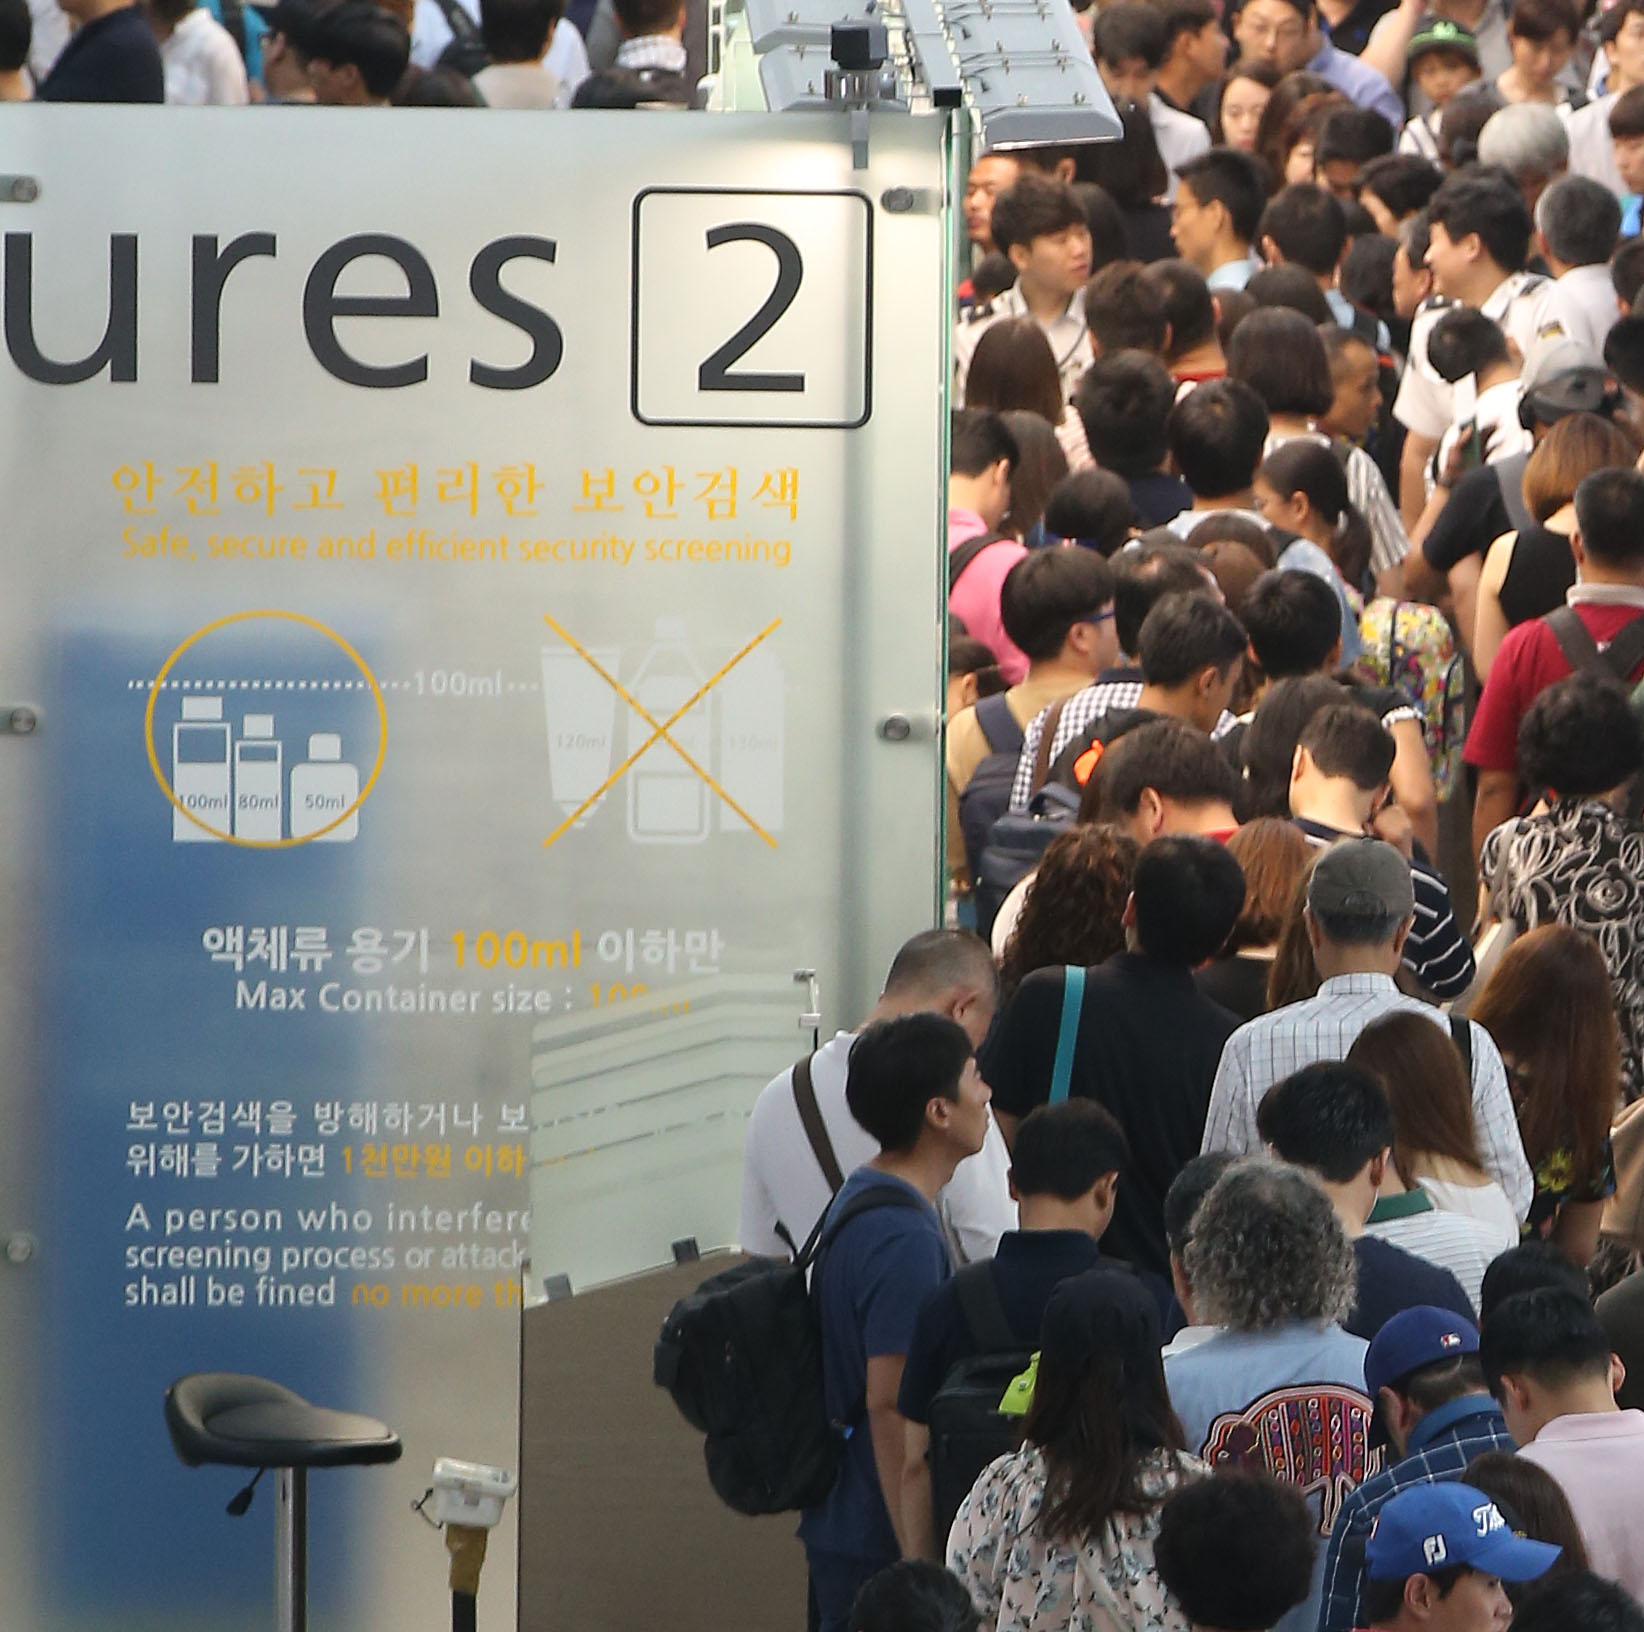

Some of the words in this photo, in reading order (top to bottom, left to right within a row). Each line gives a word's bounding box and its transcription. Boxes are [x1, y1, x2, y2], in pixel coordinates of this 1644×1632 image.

[2, 230, 564, 389] ures
[697, 223, 806, 392] 2
[111, 460, 344, 518] 안전하고
[375, 460, 546, 518] 편리한
[572, 465, 800, 523] 보안검색
[121, 526, 197, 562] Safe,
[208, 534, 308, 560] secure
[318, 528, 376, 560] and
[385, 528, 510, 562] efficient
[519, 530, 633, 566] security
[644, 530, 792, 567] screening
[413, 670, 502, 697] 100ml
[177, 793, 229, 810] 100ml
[238, 793, 279, 810] 80ml
[304, 793, 345, 810] 50ml
[202, 925, 332, 972] 액체류
[345, 926, 430, 974] 용기
[451, 929, 582, 969] 100ml
[596, 928, 725, 974] 이하만
[234, 979, 306, 1010] Max
[318, 979, 482, 1013] Container
[492, 982, 552, 1013] size
[126, 1101, 297, 1136] 보안검색을
[313, 1101, 484, 1136] 방해하거나
[125, 1143, 223, 1178] 위해를
[231, 1143, 327, 1178] 가하면
[342, 1143, 453, 1179] 1천만원
[125, 1203, 151, 1232] A
[164, 1206, 283, 1237] person
[298, 1202, 373, 1233] who
[125, 1239, 272, 1273] screening
[281, 1245, 396, 1273] process
[404, 1246, 434, 1269] or
[442, 1239, 527, 1270] attack
[125, 1276, 197, 1306] shall
[206, 1276, 246, 1306] be
[256, 1276, 336, 1306] fined
[352, 1283, 392, 1308] no
[402, 1283, 484, 1308] more
